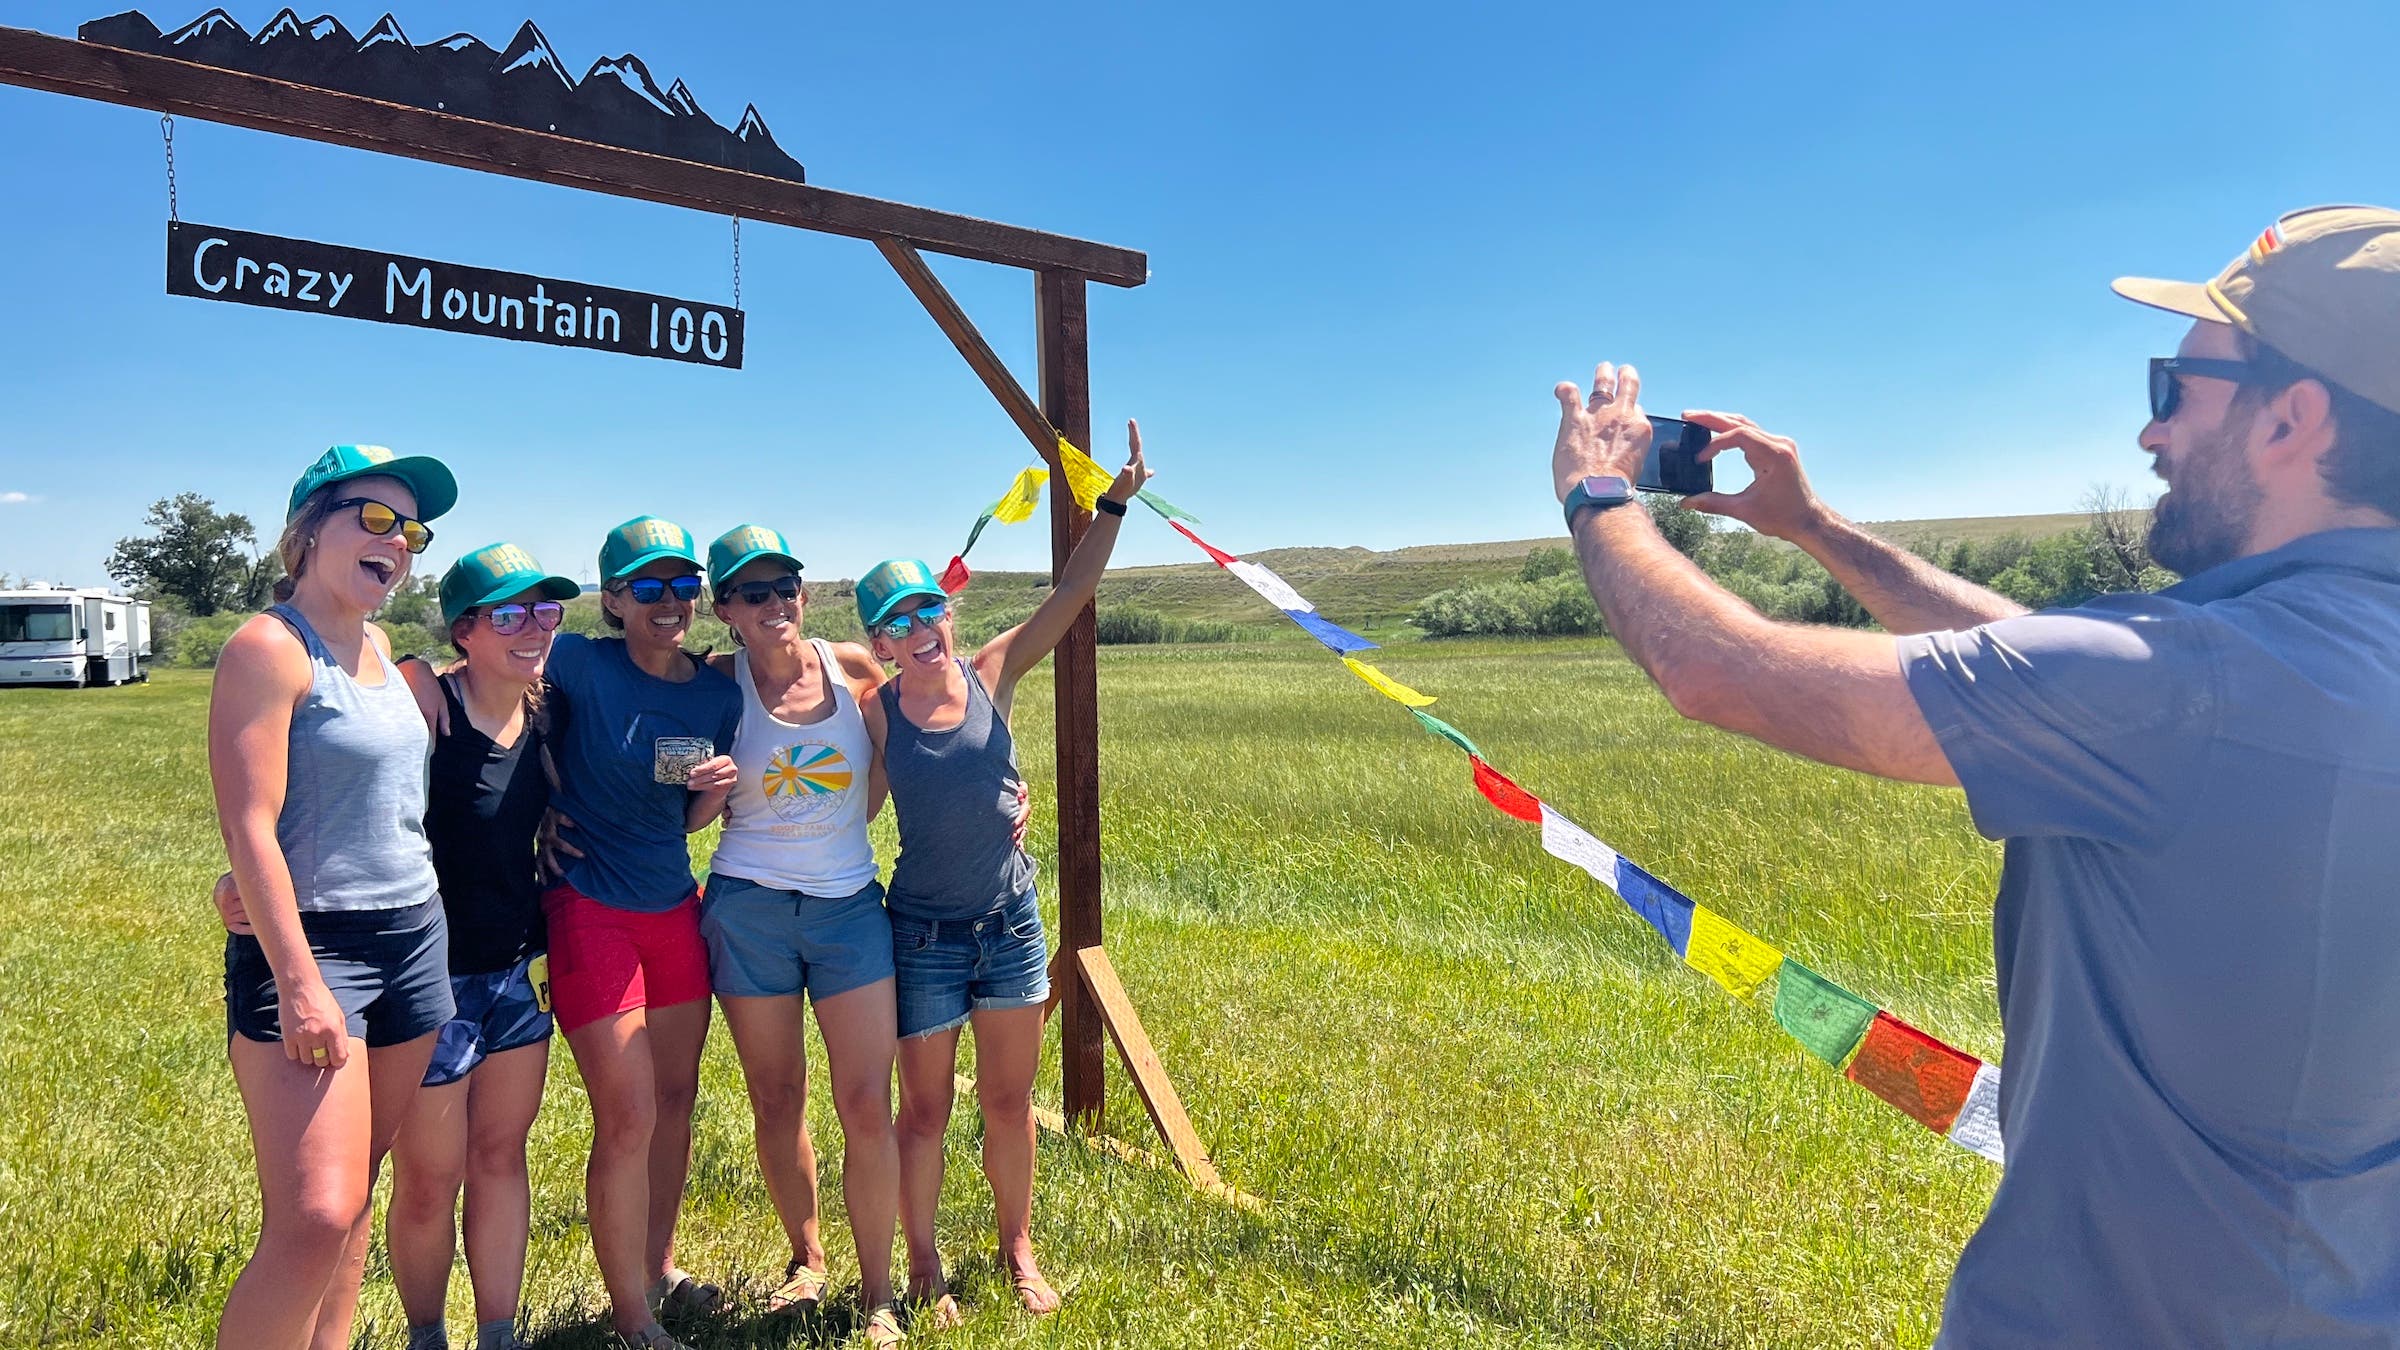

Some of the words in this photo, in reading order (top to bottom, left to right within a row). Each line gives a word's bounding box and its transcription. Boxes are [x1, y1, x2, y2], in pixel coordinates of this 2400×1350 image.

[193, 237, 354, 309] Crazy
[385, 261, 621, 343] Mountain
[649, 302, 728, 362] 100
